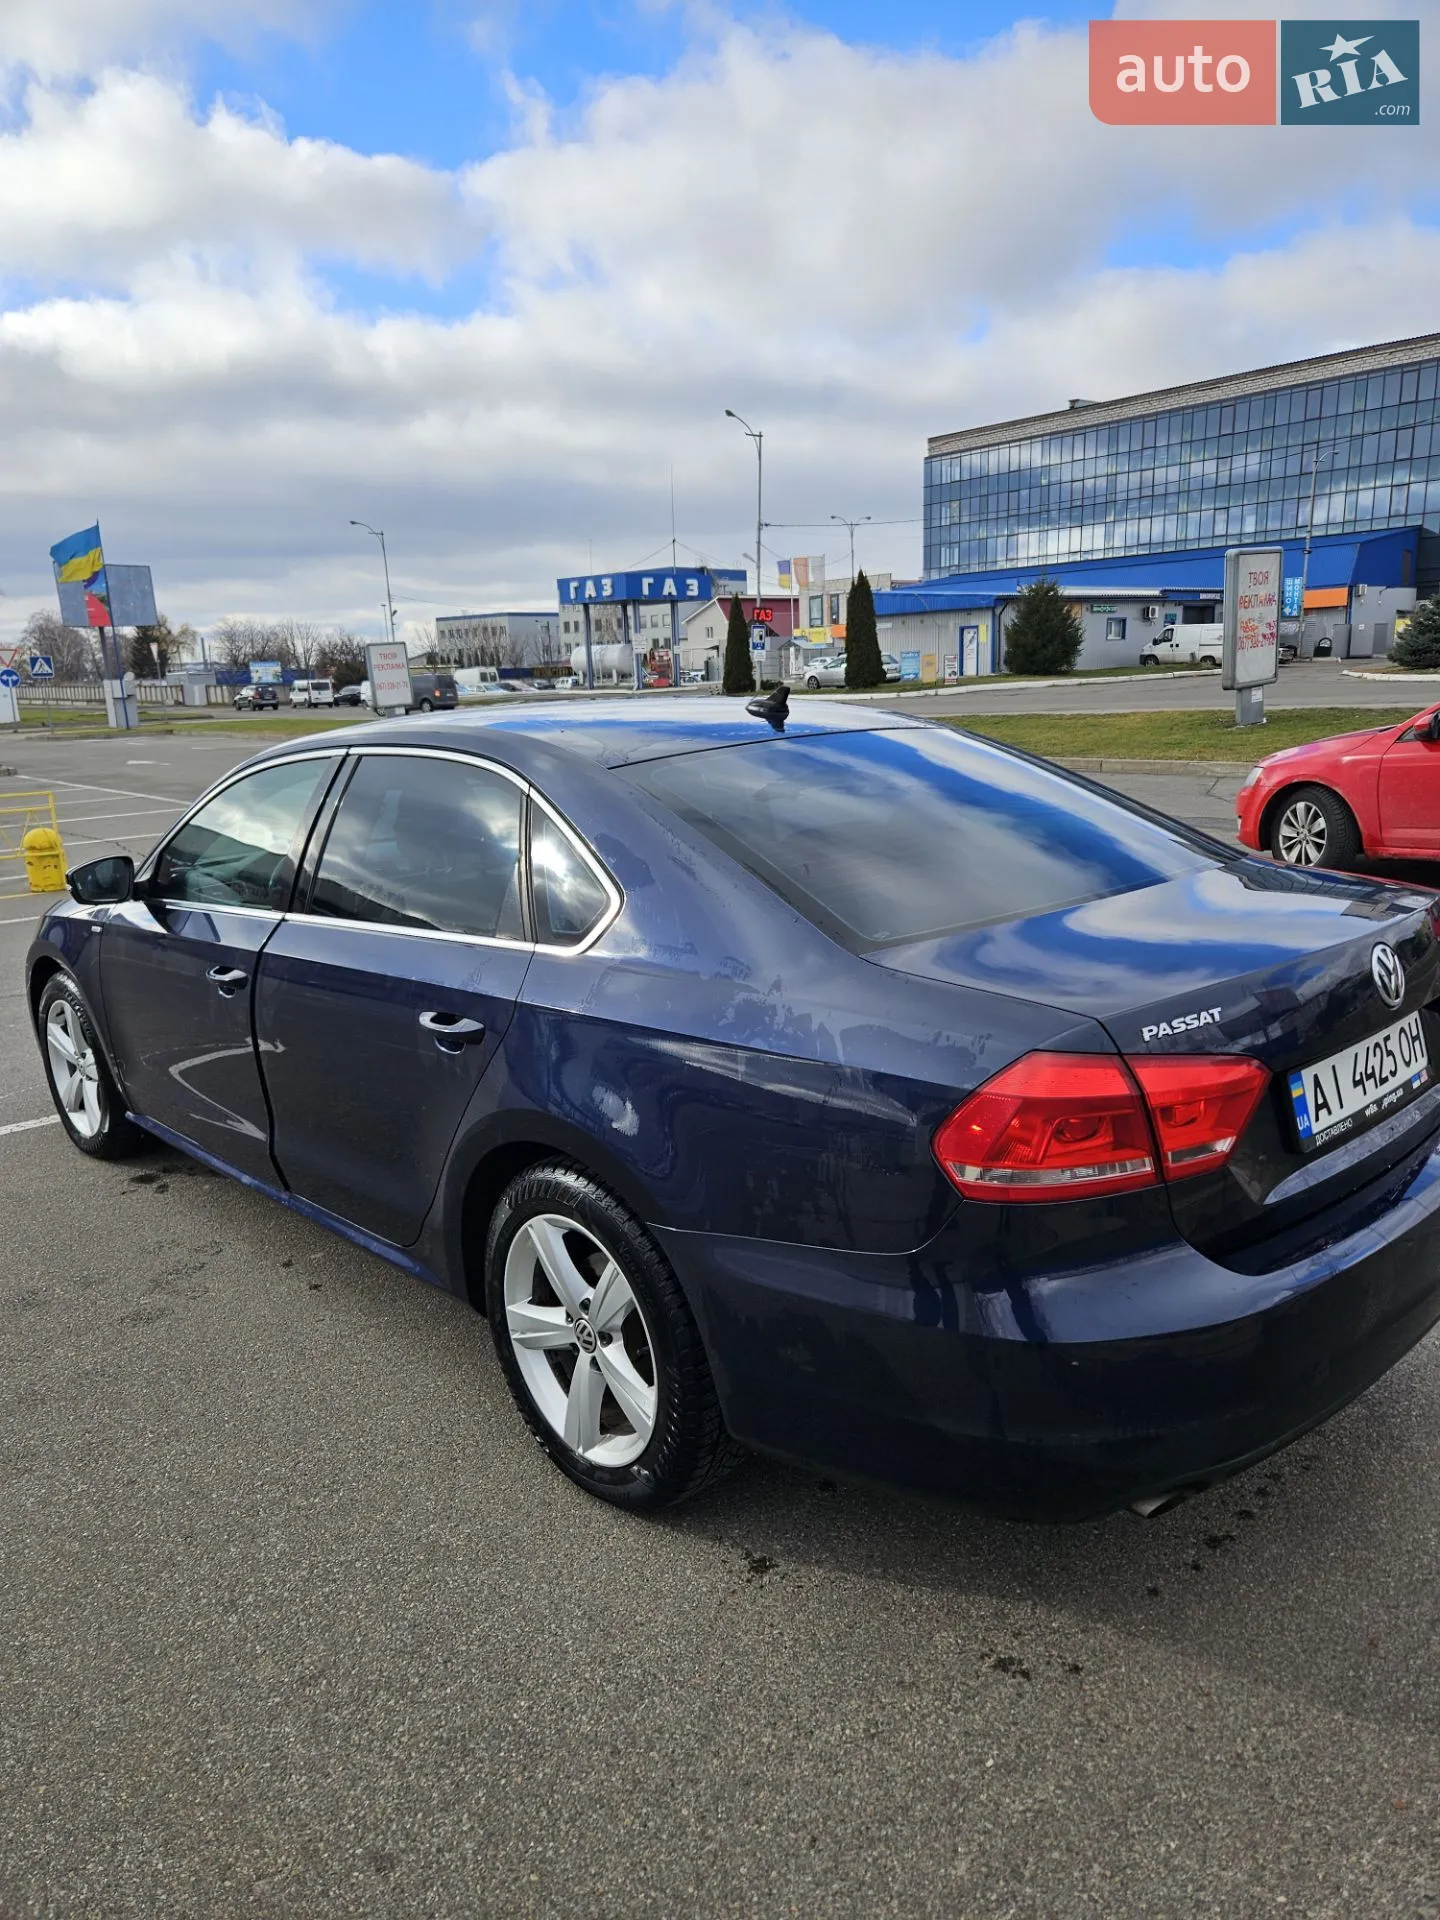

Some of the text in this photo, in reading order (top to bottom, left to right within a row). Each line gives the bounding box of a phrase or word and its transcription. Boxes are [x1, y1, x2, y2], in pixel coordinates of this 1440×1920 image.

[569, 578, 613, 600] ГАЗ
[641, 577, 699, 597] ГАЗ
[1248, 570, 1269, 588] ТВОЯ
[753, 609, 772, 621] ГАЗ
[1141, 1006, 1222, 1042] PASSAT
[1352, 1034, 1398, 1097] 4425
[1296, 1113, 1310, 1131] UA
[1315, 1117, 1353, 1146] ДОСТАВЛЕНО
